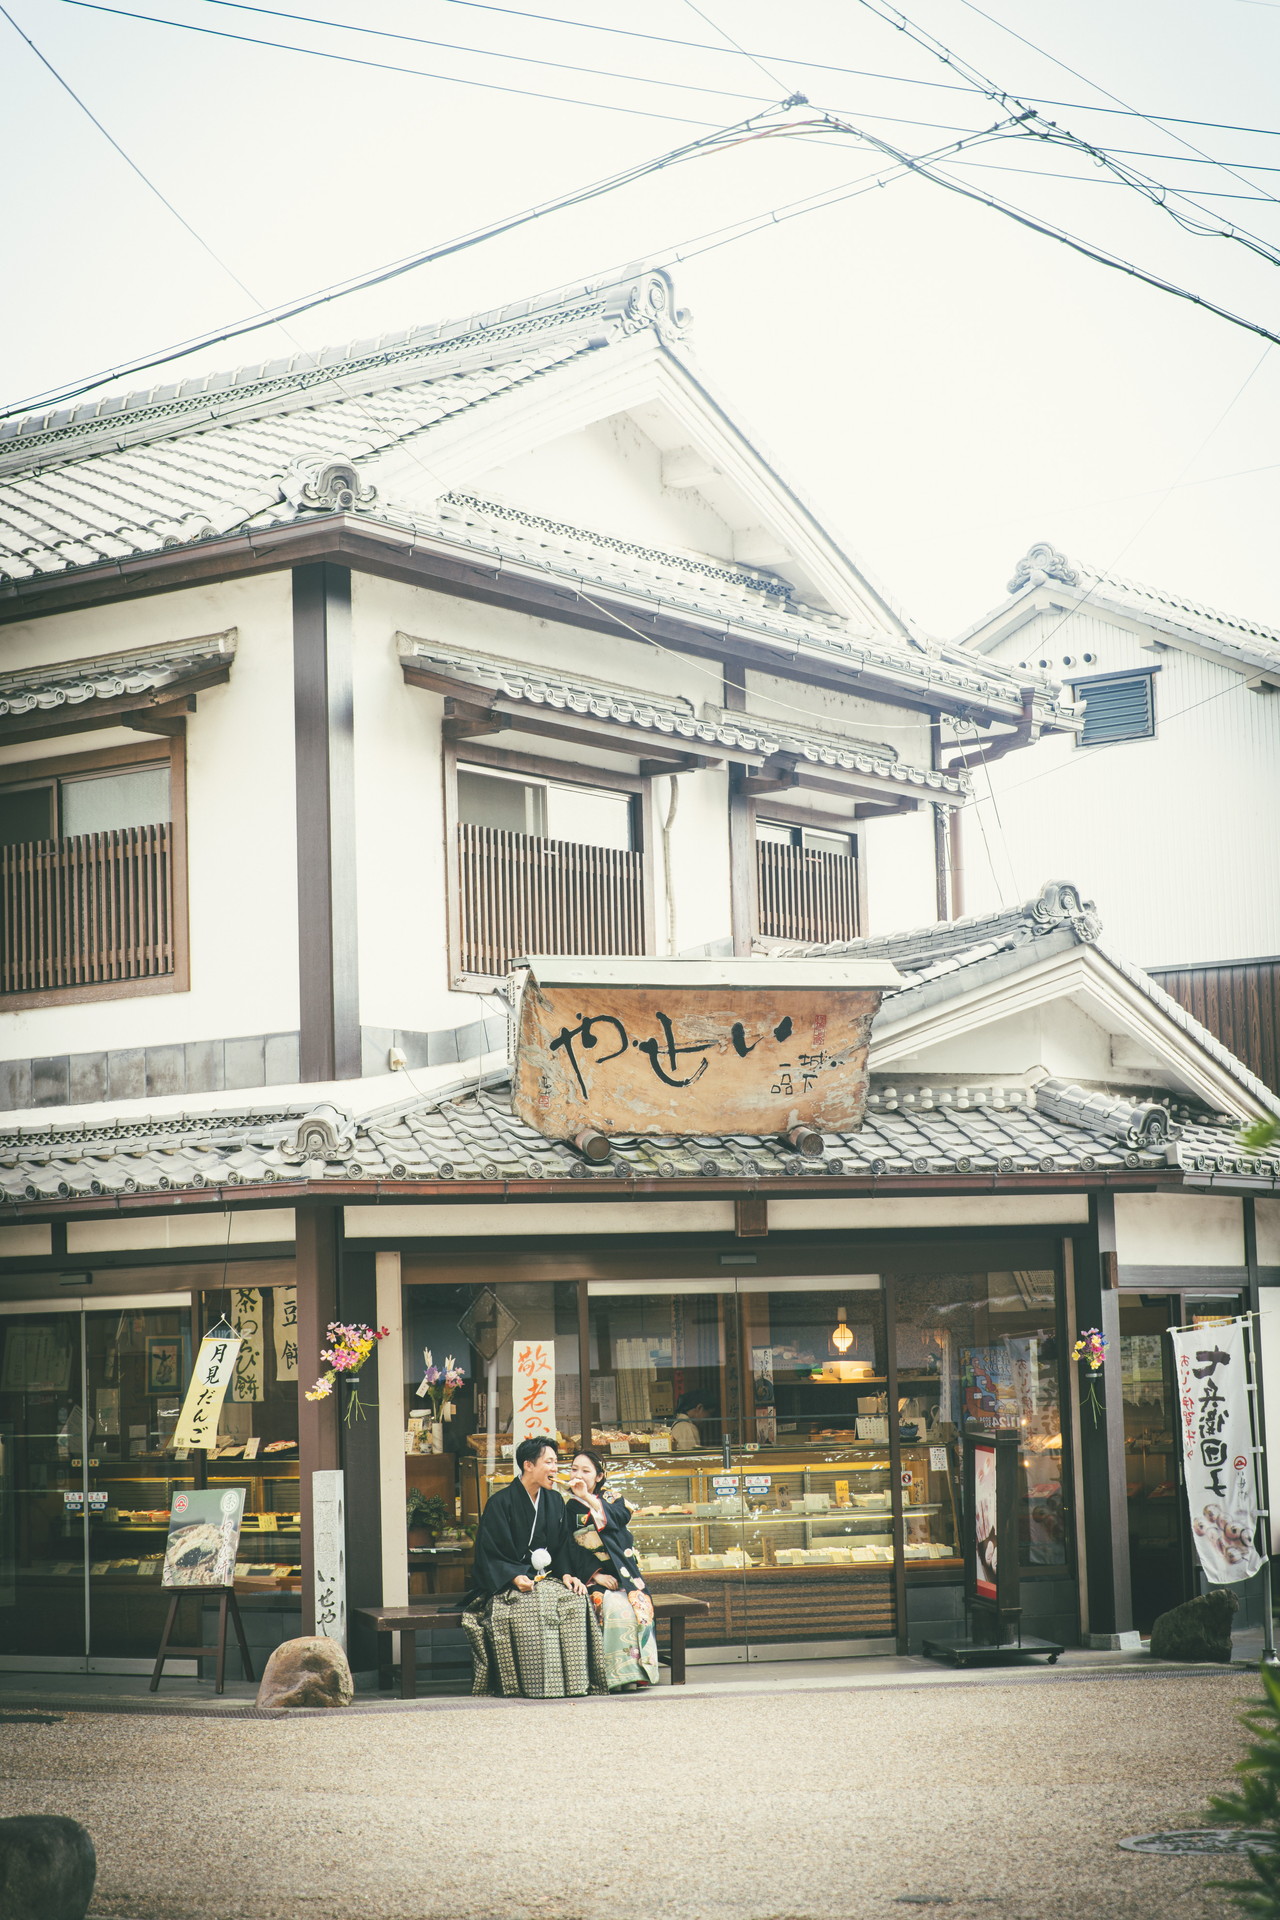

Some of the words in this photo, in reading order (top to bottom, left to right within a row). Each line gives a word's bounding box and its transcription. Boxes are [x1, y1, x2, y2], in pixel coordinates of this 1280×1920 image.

[281, 1286, 298, 1370] 豆餅
[190, 1343, 228, 1444] 月見だんご
[316, 1569, 337, 1637] いせや
